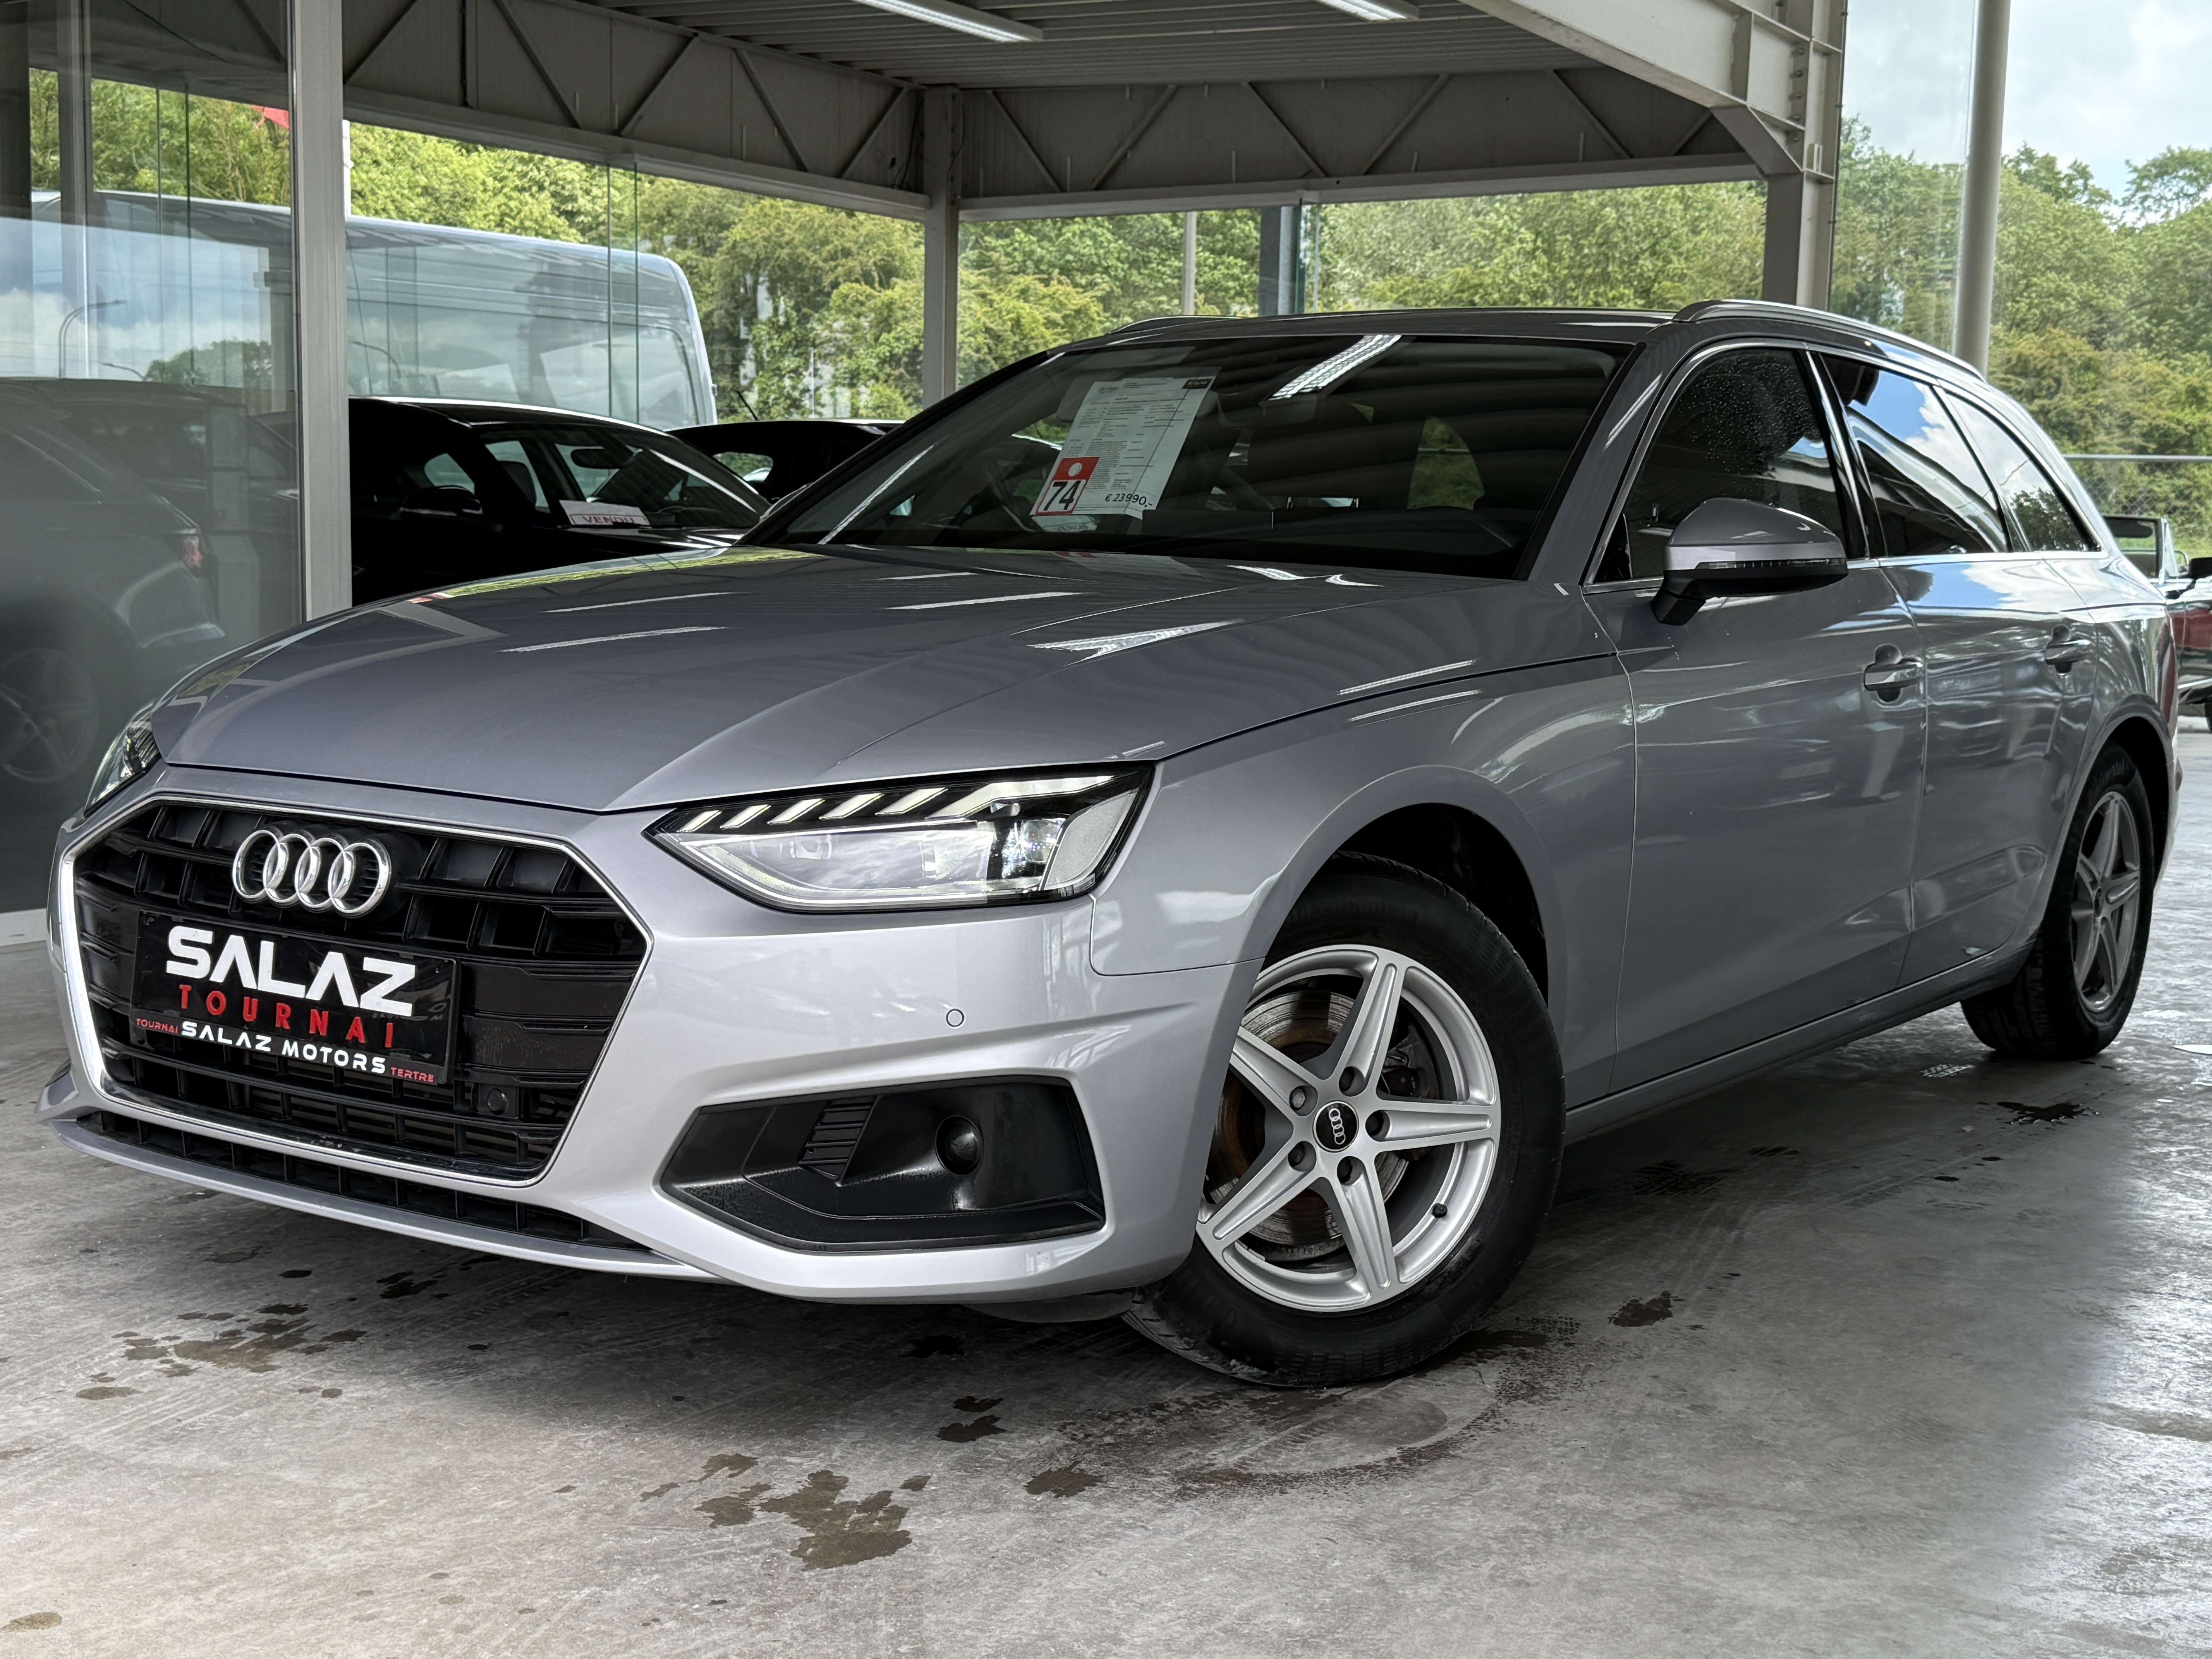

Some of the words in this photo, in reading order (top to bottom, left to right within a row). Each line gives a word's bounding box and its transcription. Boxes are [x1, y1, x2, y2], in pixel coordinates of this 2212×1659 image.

[1043, 480, 1082, 511] 74
[166, 926, 416, 1017] SALAZ
[179, 984, 394, 1048] TOURNAI
[136, 1018, 179, 1034] TOURNAI
[181, 1021, 271, 1052] SALAZ
[282, 1039, 386, 1074] MOTORS
[390, 1067, 434, 1083] TERTRE
